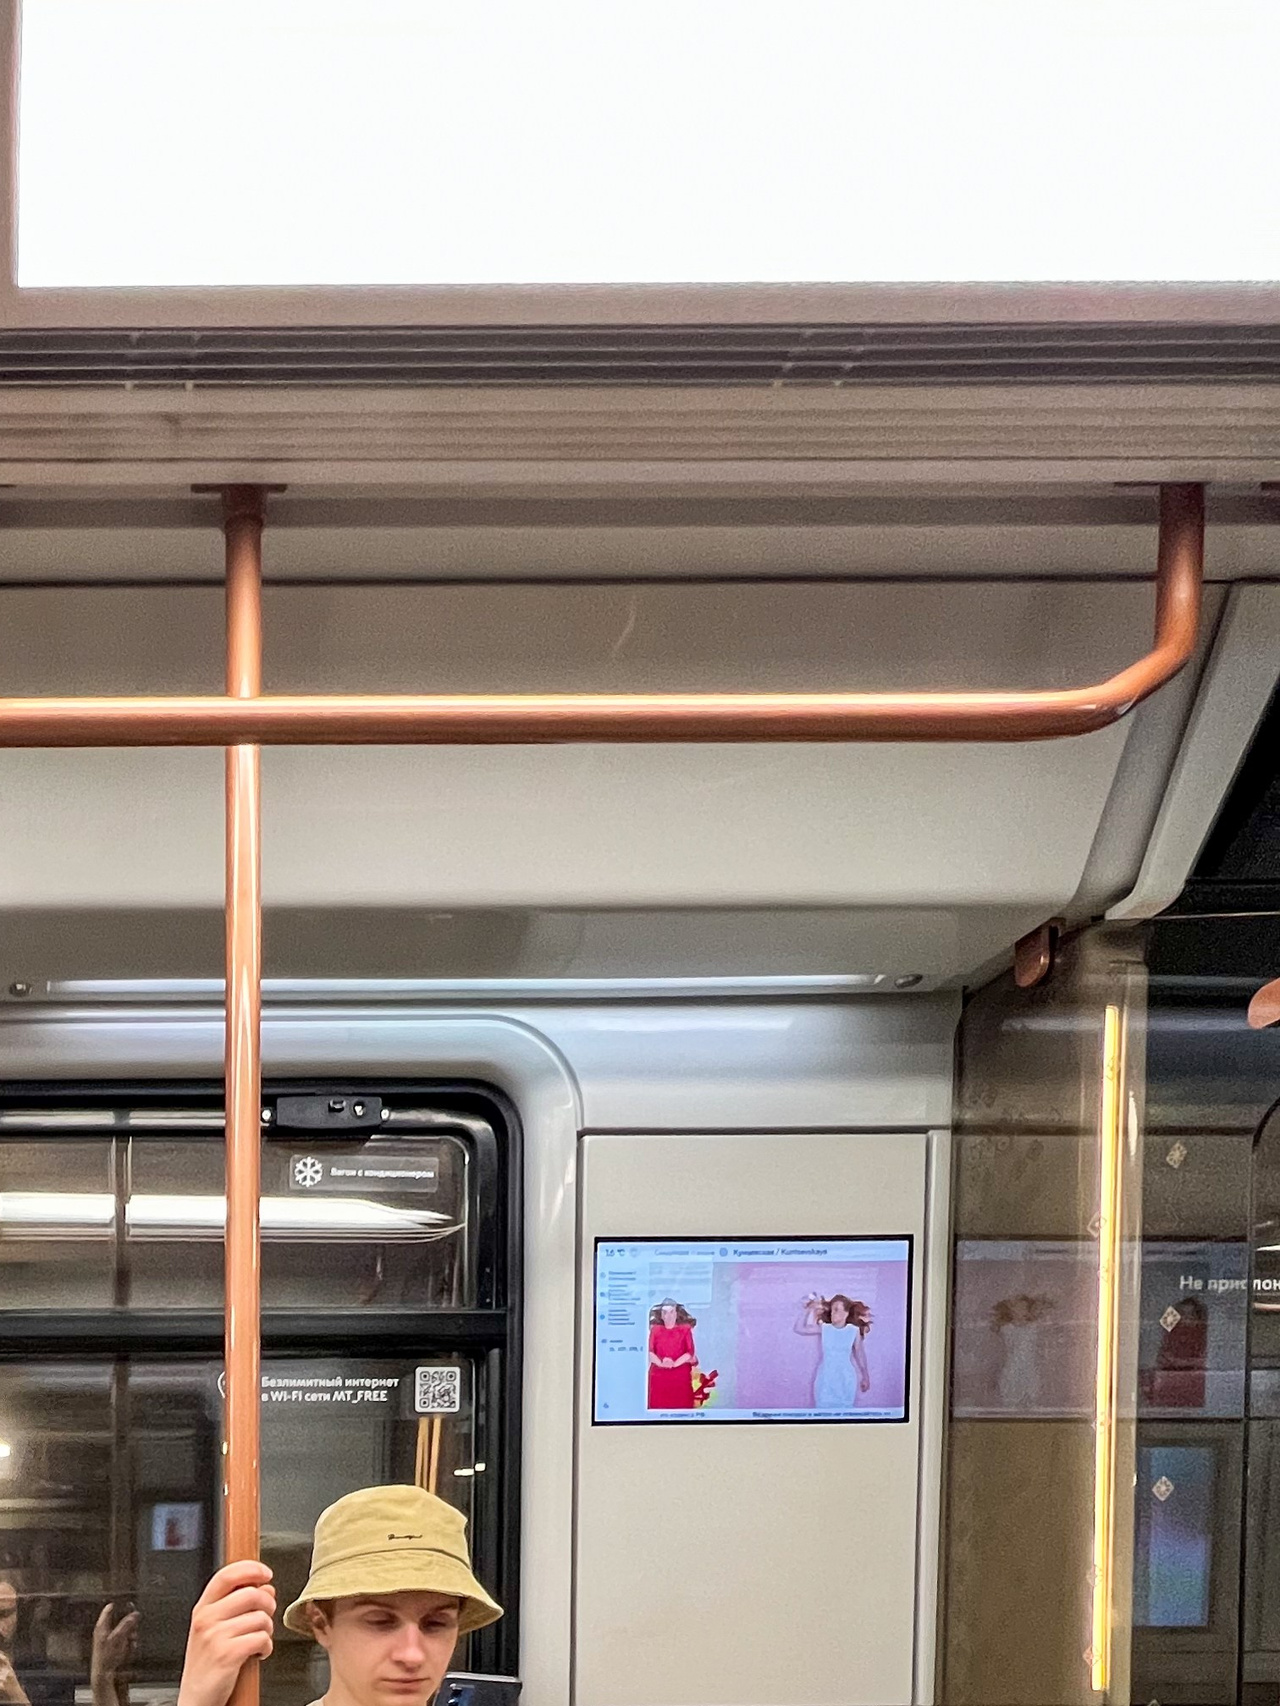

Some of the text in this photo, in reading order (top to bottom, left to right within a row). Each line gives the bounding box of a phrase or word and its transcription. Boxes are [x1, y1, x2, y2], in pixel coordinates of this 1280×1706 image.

[1179, 1275, 1203, 1290] Не
[261, 1376, 400, 1390] Безлимитный интернет
[261, 1392, 269, 1402] в
[304, 1392, 331, 1402] сети
[331, 1390, 388, 1404] MT_FREE
